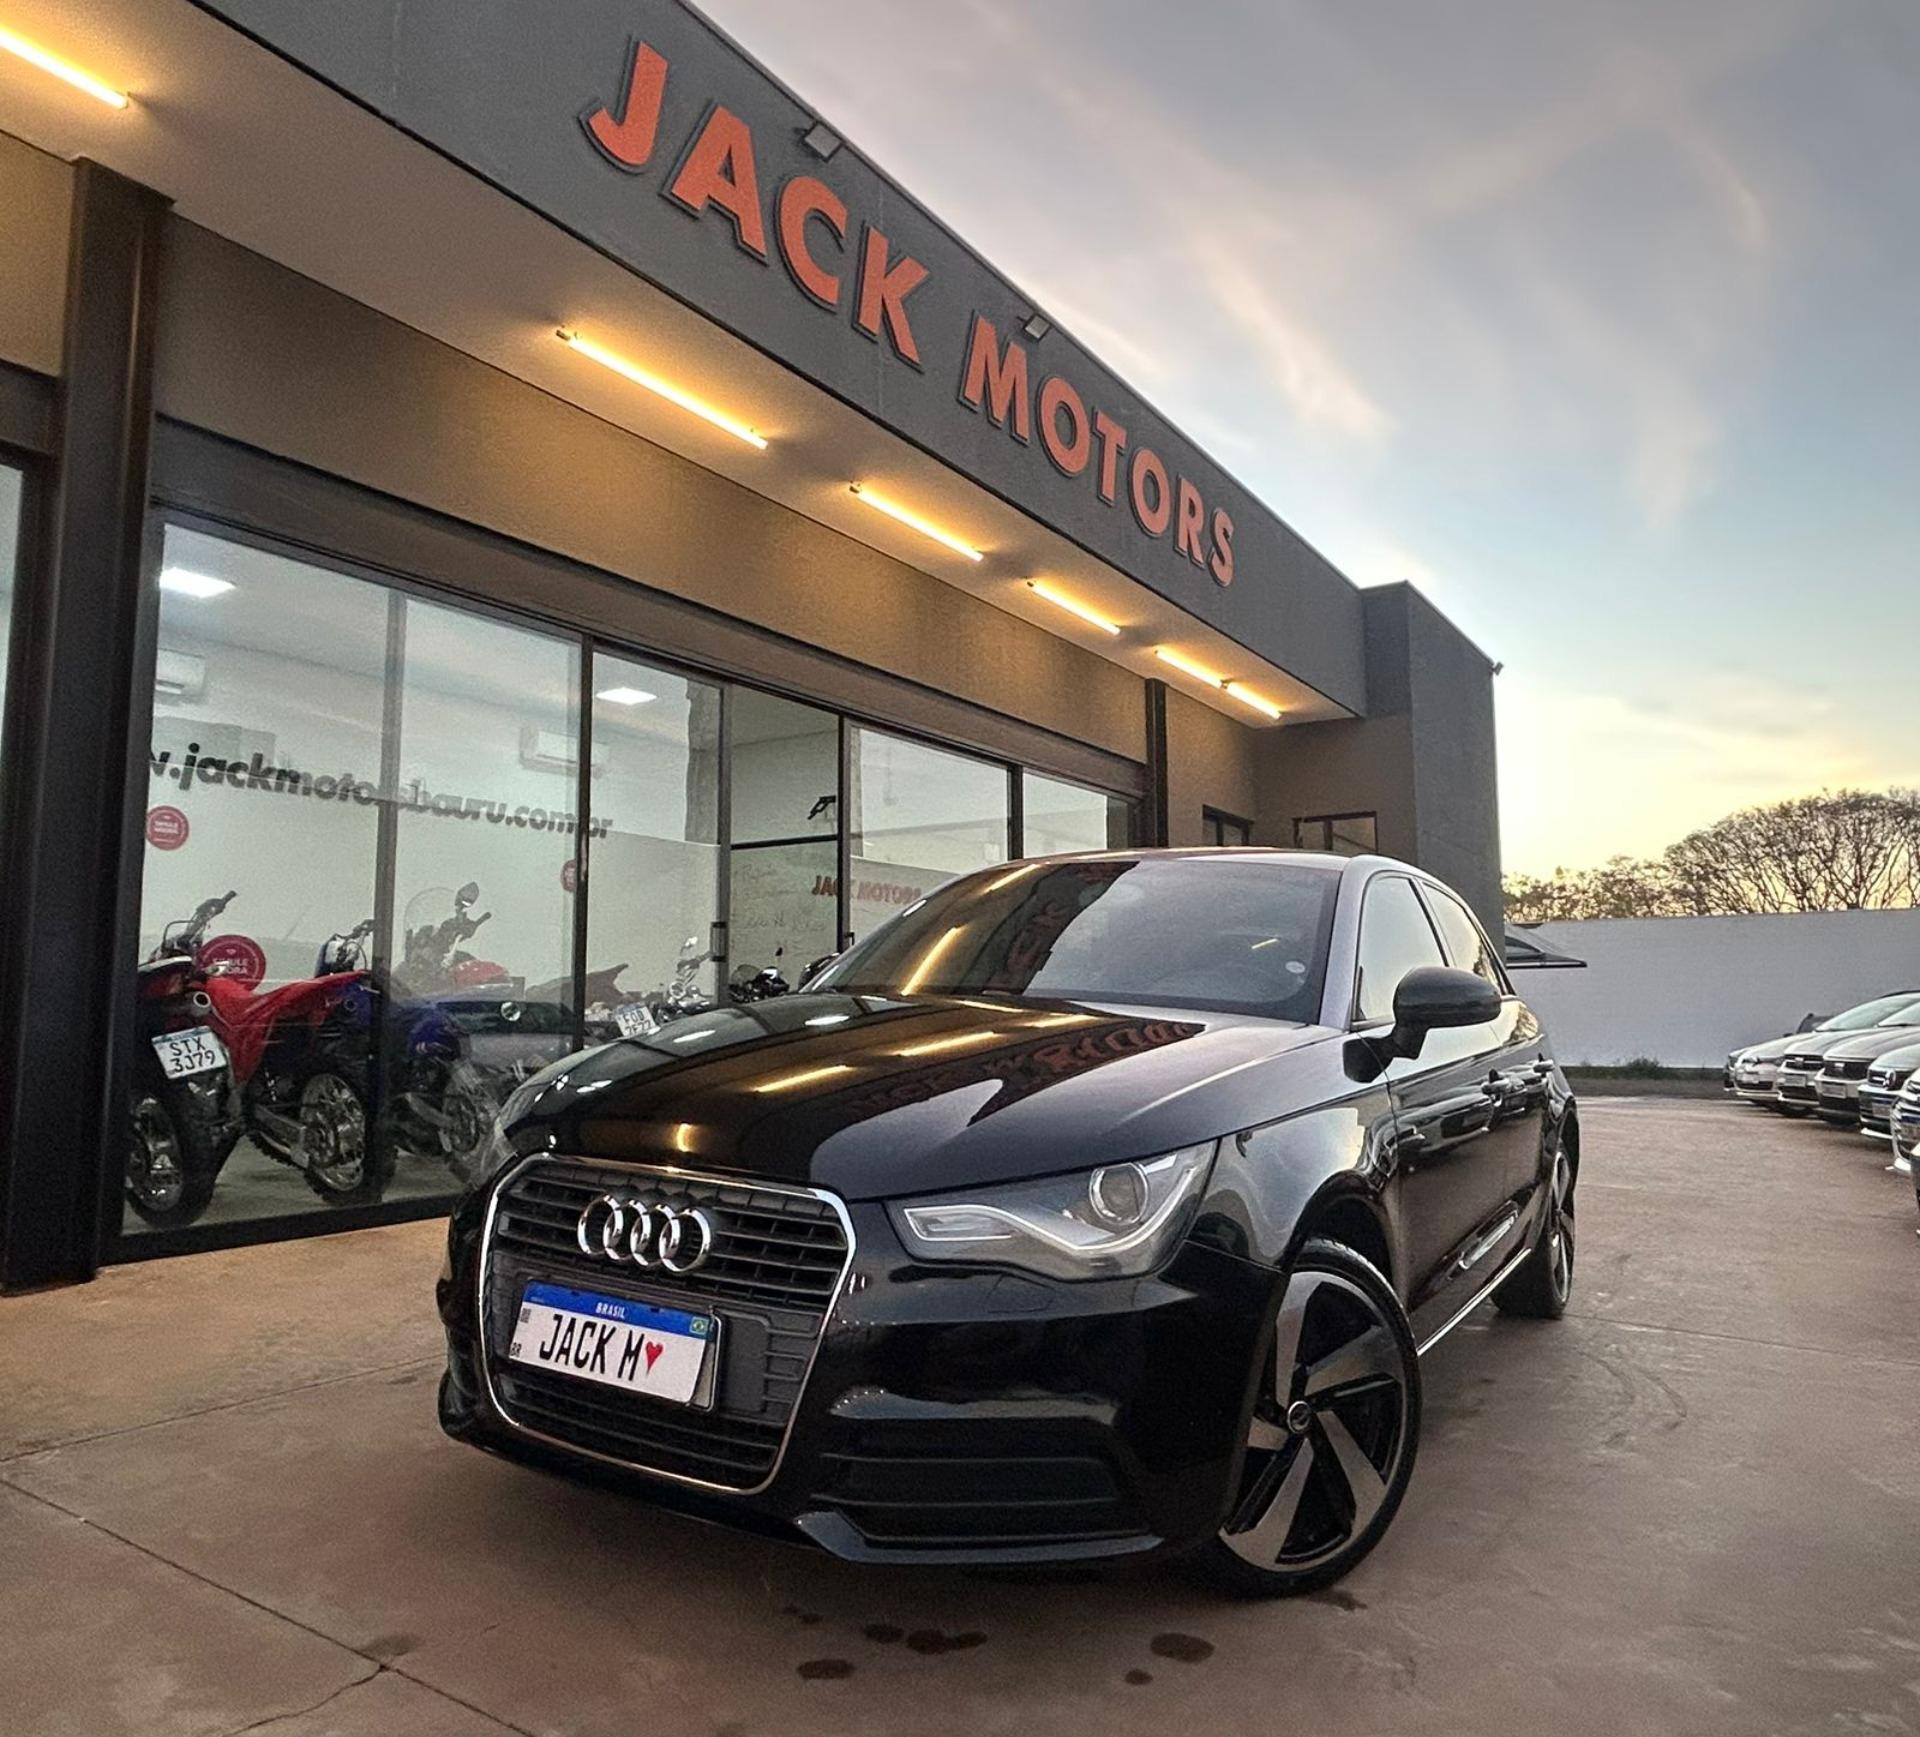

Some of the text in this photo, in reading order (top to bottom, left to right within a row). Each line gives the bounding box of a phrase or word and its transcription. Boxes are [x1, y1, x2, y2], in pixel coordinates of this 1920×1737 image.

[585, 40, 1234, 587] JACK MOTORS
[169, 1036, 206, 1057] STX
[170, 1049, 216, 1073] 3J79
[595, 1302, 627, 1320] BRASIL
[539, 1313, 645, 1382] JACK M
